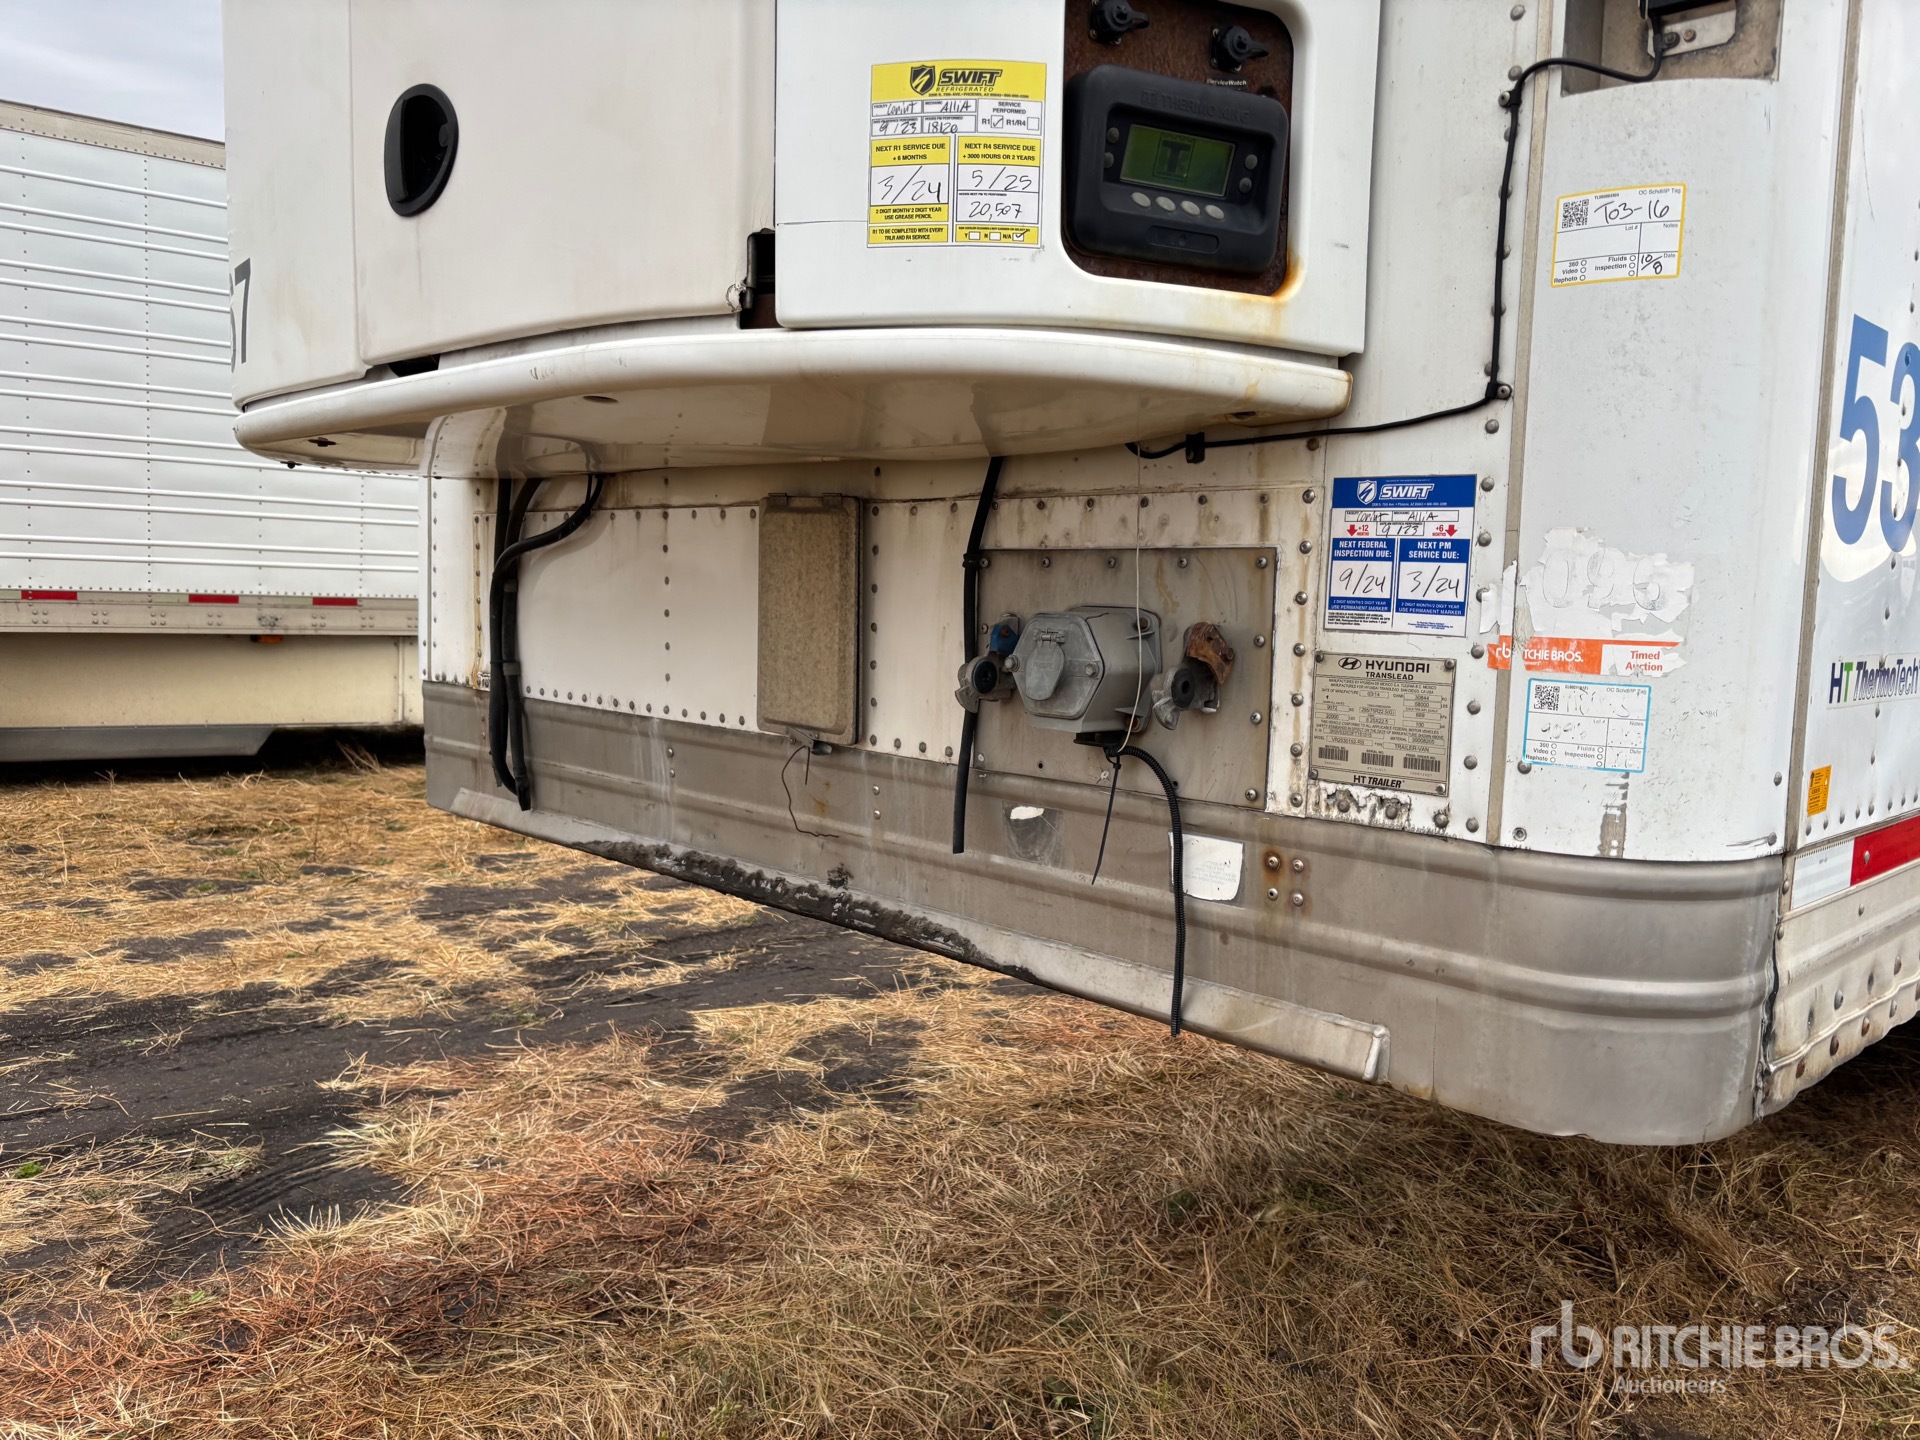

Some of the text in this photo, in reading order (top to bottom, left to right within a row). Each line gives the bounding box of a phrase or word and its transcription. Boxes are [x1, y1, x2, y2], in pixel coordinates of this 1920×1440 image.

[938, 69, 1003, 86] SWIFT
[1595, 263, 1626, 272] Inspection
[1832, 314, 1920, 553] 53
[1379, 484, 1434, 499] SWIFT
[1523, 650, 1583, 663] TCHIE BROS.
[1630, 650, 1660, 660] Timed
[1366, 660, 1430, 673] HYUNDAI
[1625, 661, 1663, 672] Auction
[1366, 672, 1413, 680] TRANSLEAD
[1829, 662, 1853, 704] HT
[1354, 775, 1402, 788] HT TRAILER
